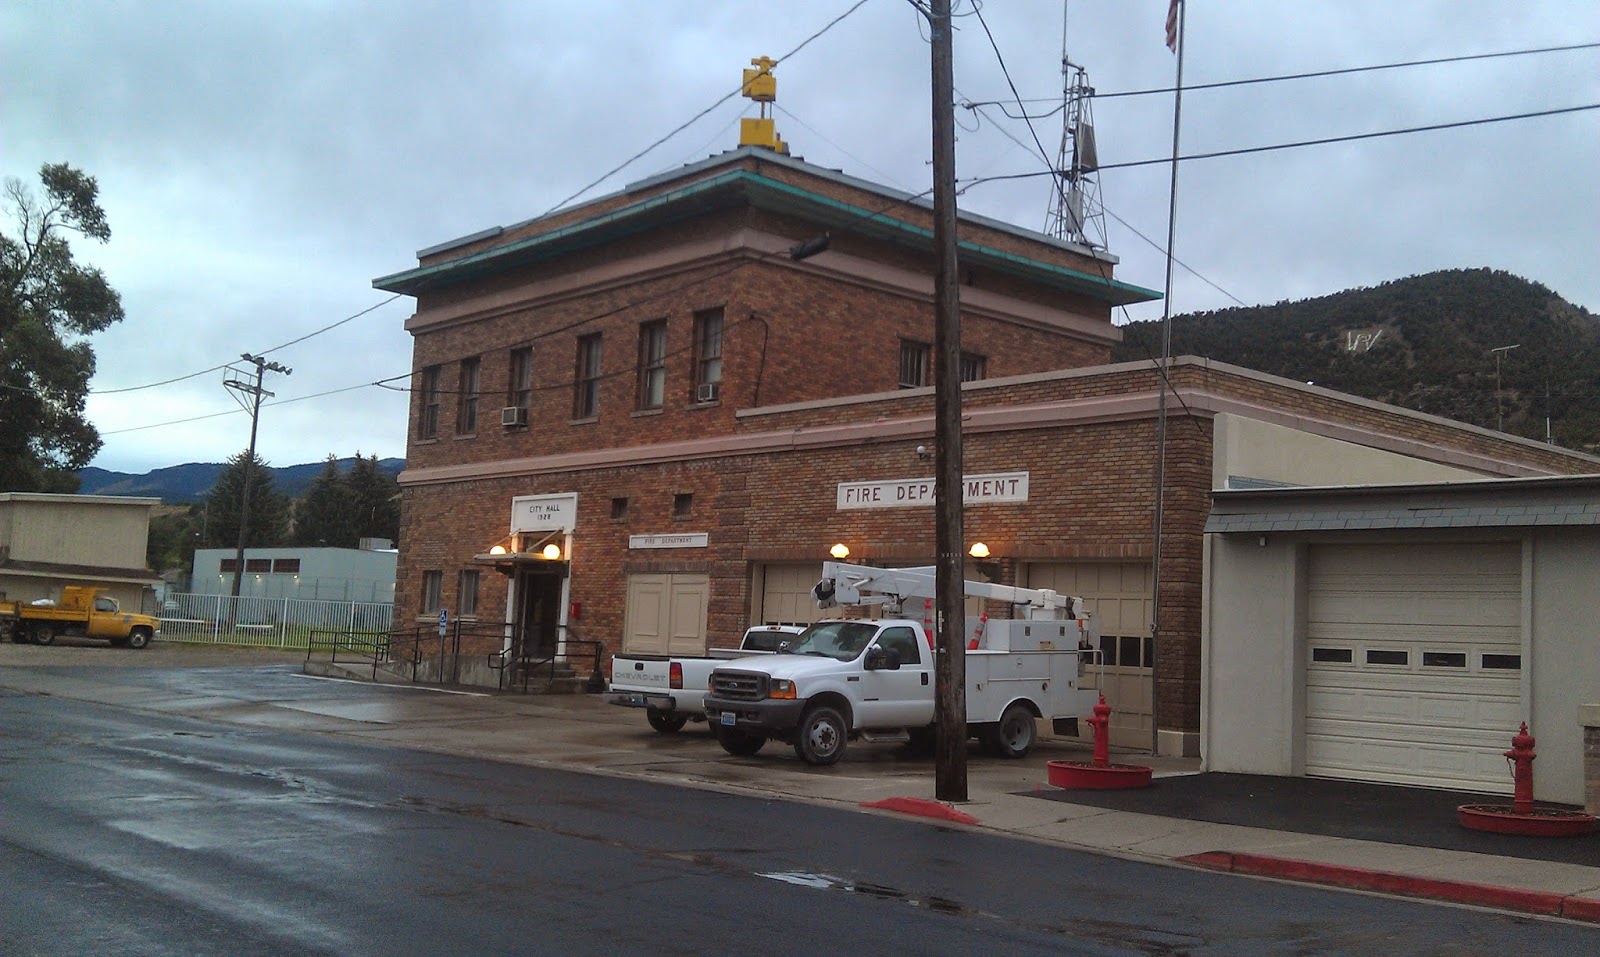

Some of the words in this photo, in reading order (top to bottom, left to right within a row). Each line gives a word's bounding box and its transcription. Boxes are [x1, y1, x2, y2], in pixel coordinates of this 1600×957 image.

[846, 487, 881, 503] FIRE
[896, 479, 1019, 501] DEPAMENT
[529, 505, 543, 513] CITY
[545, 504, 560, 512] HALL
[614, 671, 666, 682] CHEVROLET
